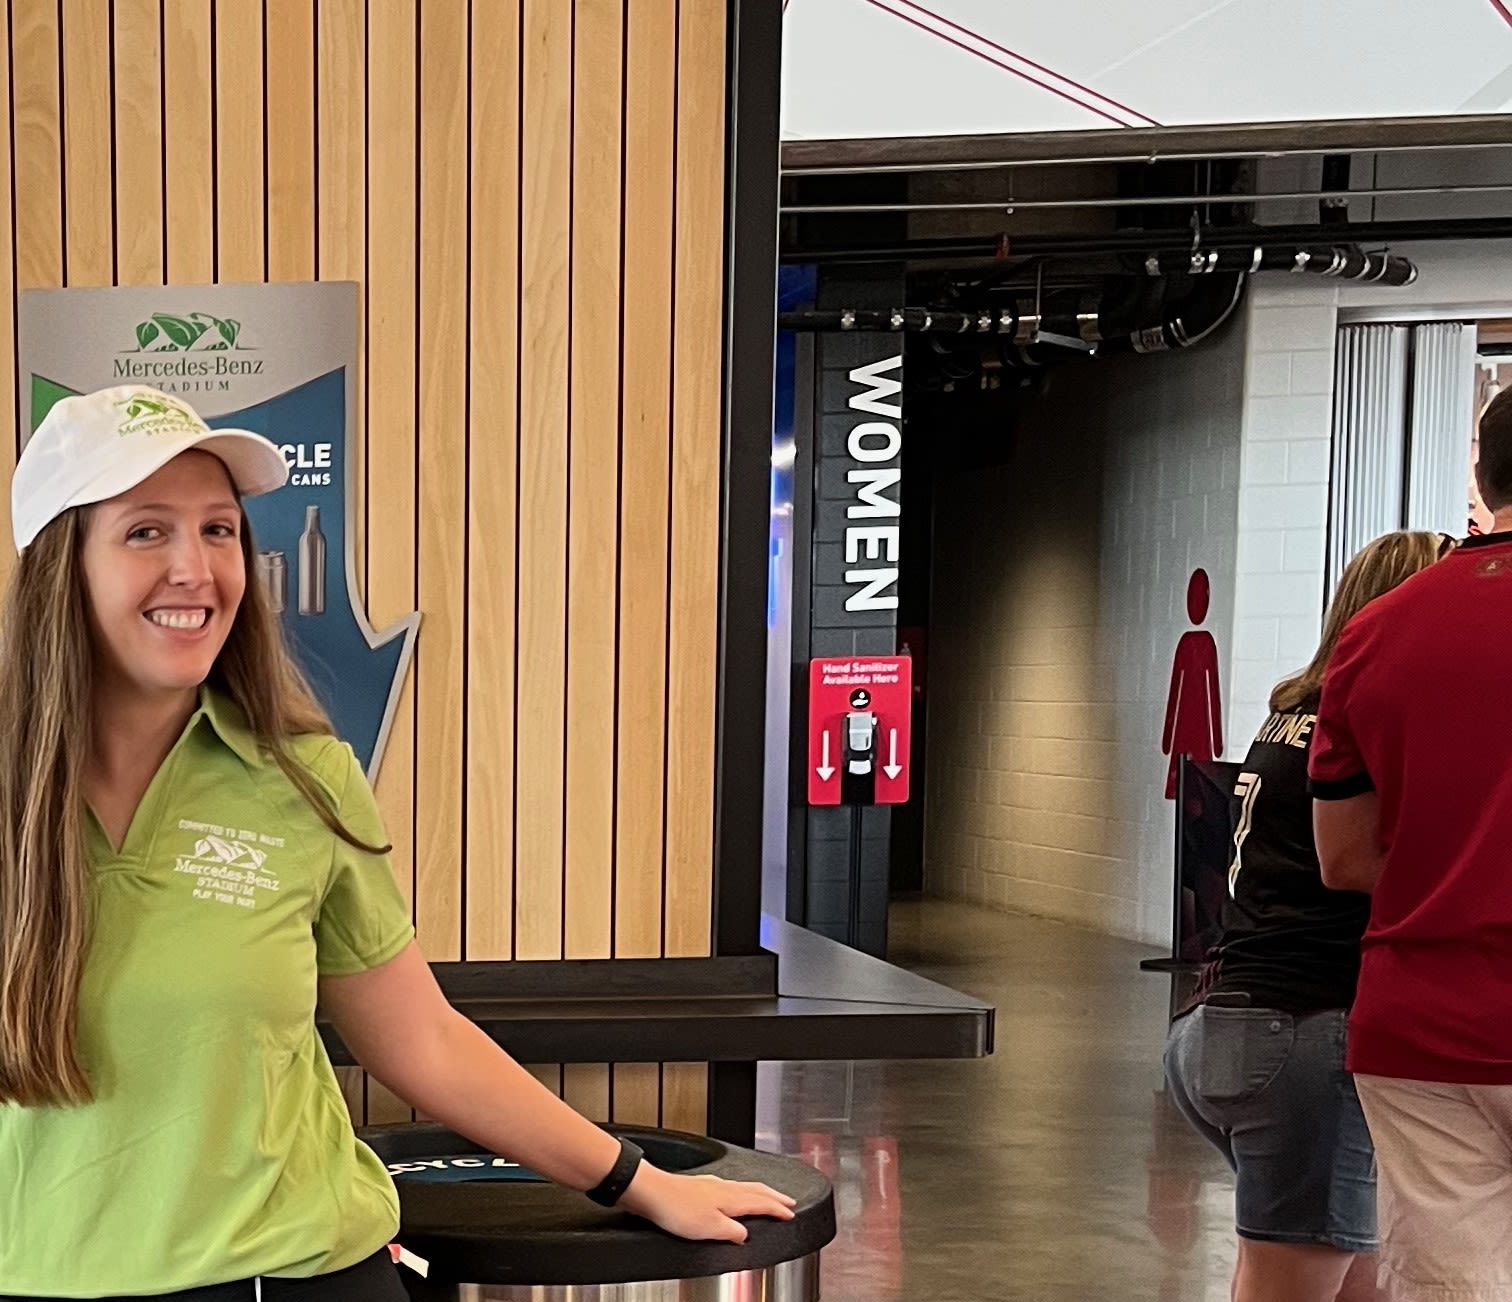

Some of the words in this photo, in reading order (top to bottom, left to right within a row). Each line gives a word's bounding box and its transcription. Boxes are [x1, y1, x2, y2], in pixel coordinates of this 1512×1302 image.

[112, 356, 265, 378] Mercedes-Benz
[148, 380, 231, 393] TADIUM
[276, 443, 332, 469] CLE
[291, 473, 332, 486] CANS
[844, 354, 903, 612] WOMEN
[822, 663, 851, 674] Hand
[852, 662, 900, 673] Sanitizer
[822, 674, 871, 685] Available
[871, 673, 899, 684] Here
[173, 858, 281, 891] Mercedes-Benz
[196, 876, 255, 897] STADIUM
